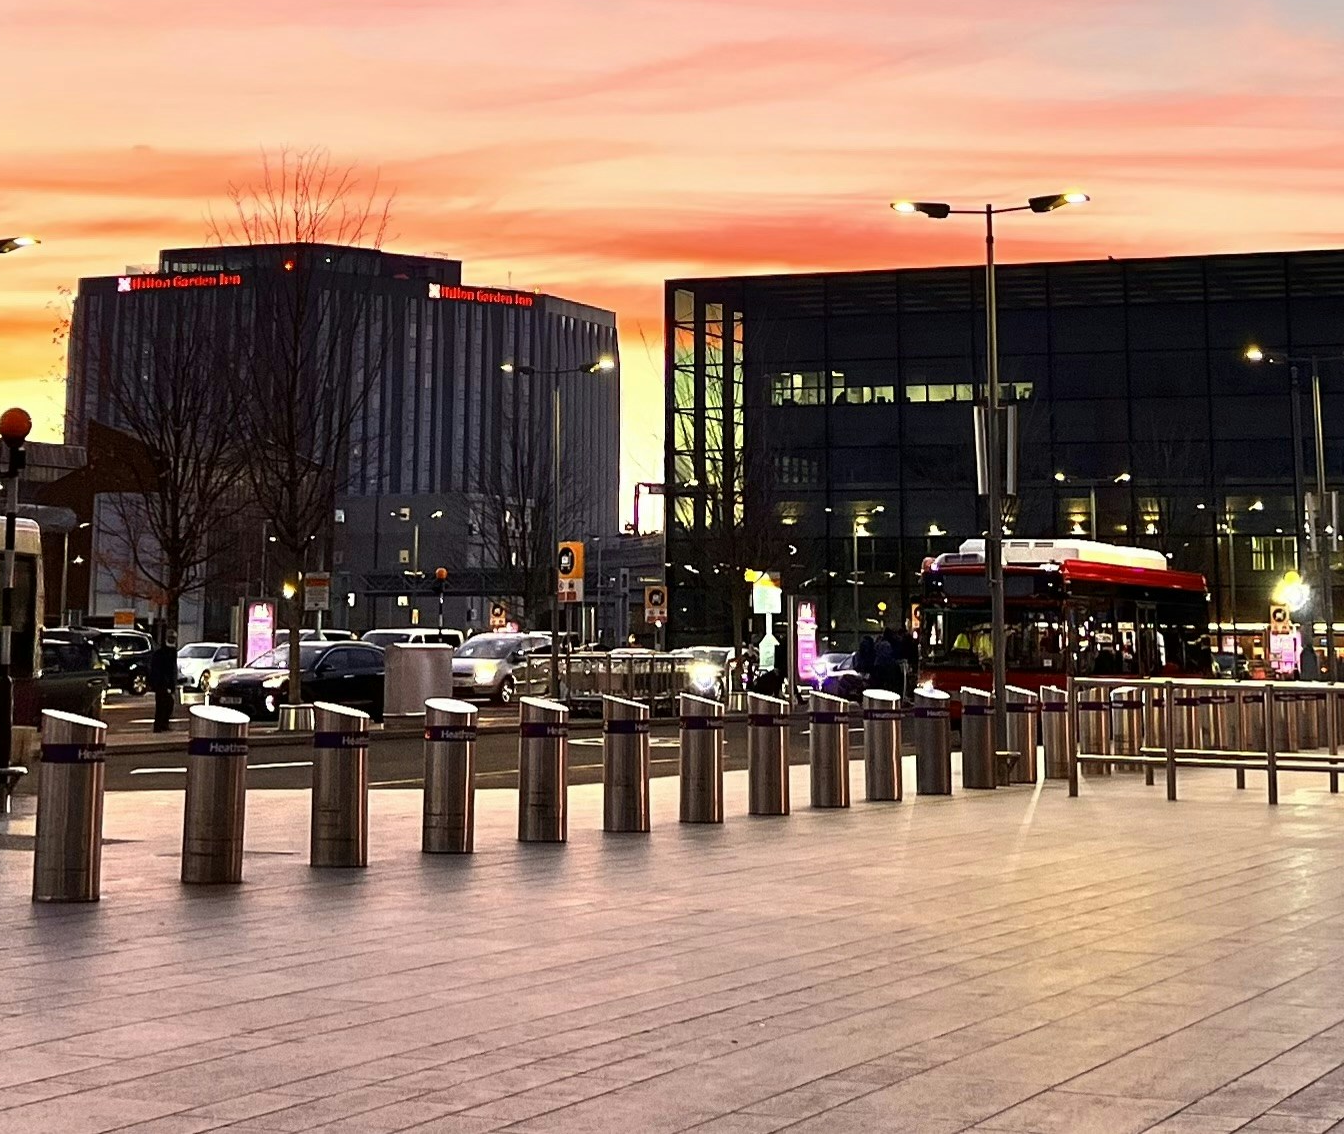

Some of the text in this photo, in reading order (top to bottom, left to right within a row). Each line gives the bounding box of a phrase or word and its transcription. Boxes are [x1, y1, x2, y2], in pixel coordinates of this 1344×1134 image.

[131, 273, 241, 290] Hilton Garden Inn
[441, 285, 533, 306] Hilton Garden Inn
